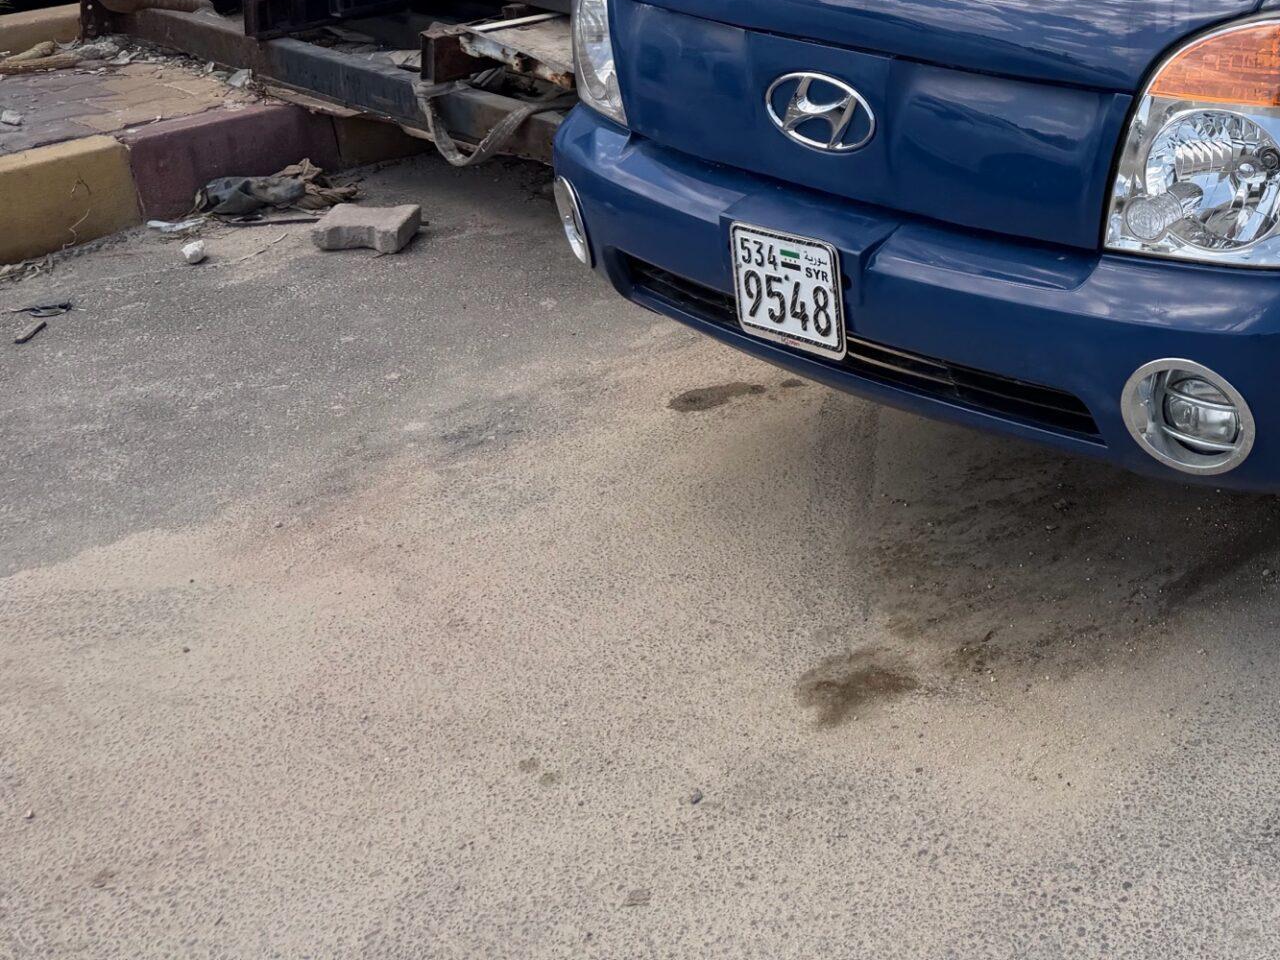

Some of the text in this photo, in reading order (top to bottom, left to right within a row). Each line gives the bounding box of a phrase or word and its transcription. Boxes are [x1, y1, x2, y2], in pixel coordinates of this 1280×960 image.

[740, 236, 778, 271] 534
[805, 266, 829, 283] SYR
[744, 269, 832, 337] 9548
